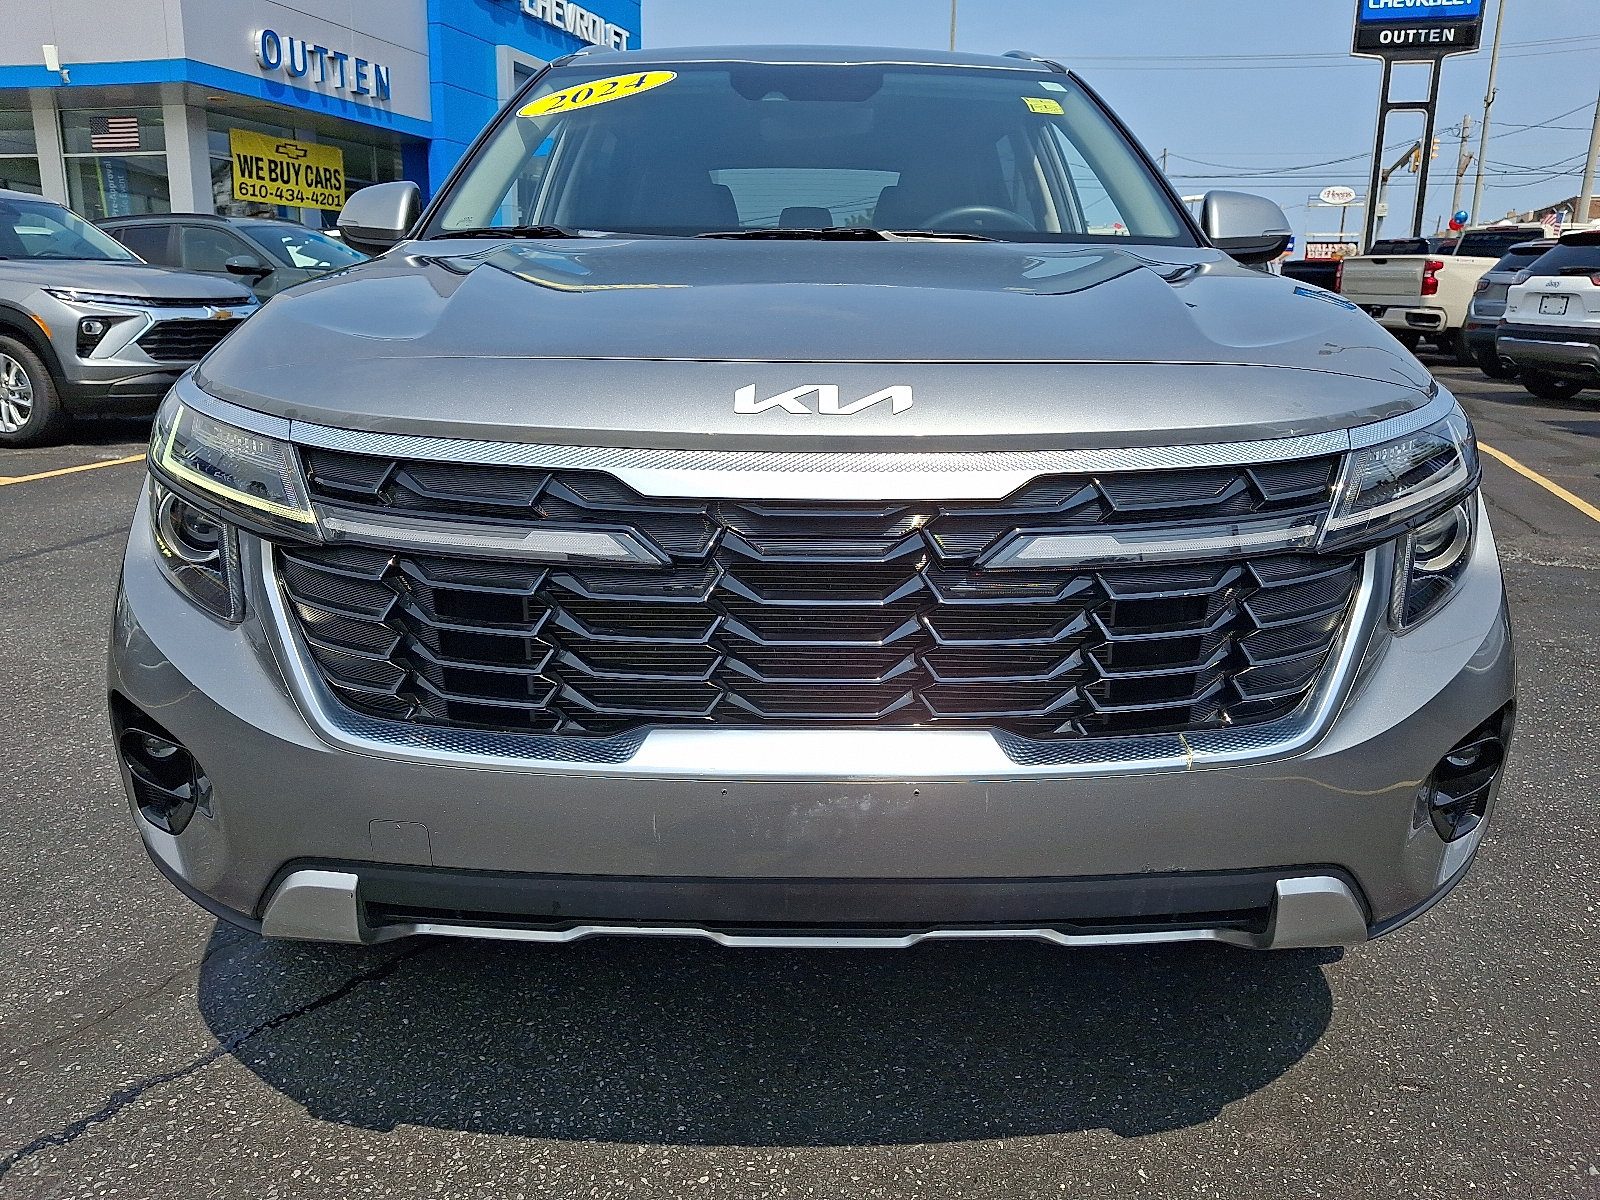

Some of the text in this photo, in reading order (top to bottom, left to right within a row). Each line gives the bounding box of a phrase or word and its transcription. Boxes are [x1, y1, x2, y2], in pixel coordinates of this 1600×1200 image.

[1379, 28, 1455, 44] OUTTEN
[255, 29, 391, 101] OUTTEN
[543, 73, 648, 114] 2024
[236, 153, 341, 191] WE BUY CARS
[239, 182, 342, 207] 610-434-4201
